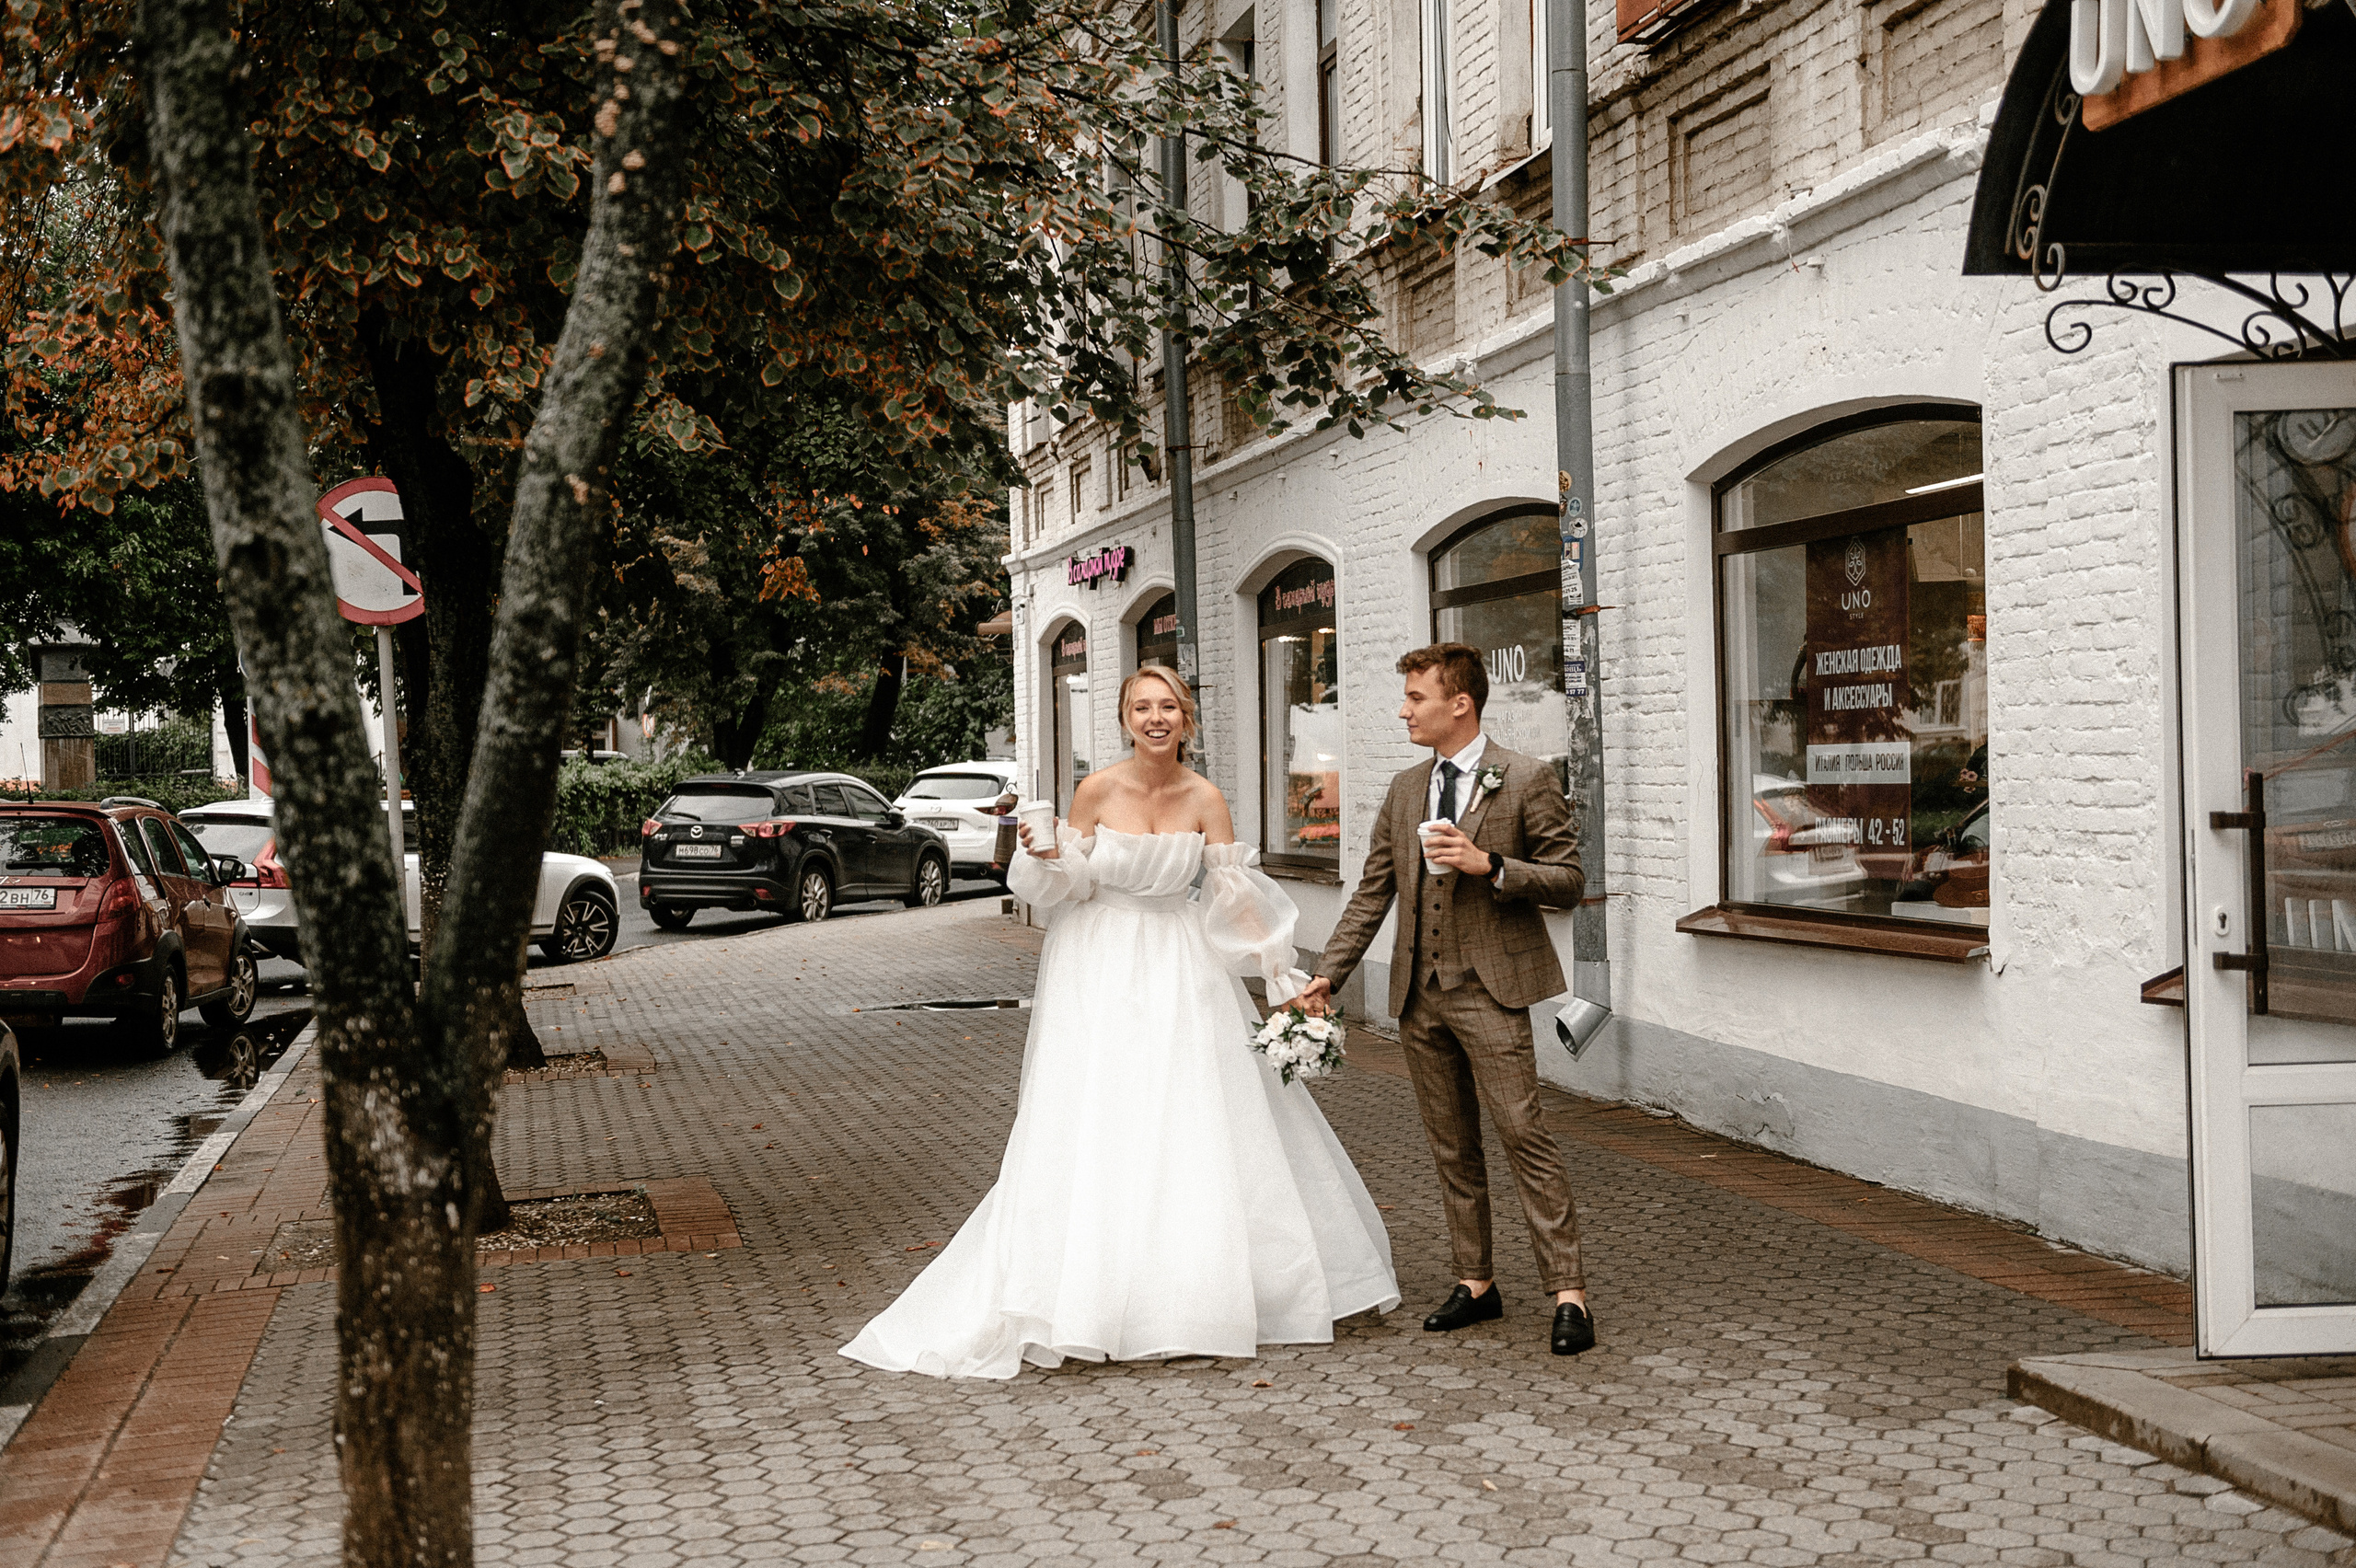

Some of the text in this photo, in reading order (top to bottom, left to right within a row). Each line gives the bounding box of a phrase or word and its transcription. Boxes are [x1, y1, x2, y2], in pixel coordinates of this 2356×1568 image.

[1842, 589, 1871, 610] UNO
[1849, 612, 1865, 620] STYLE
[1491, 644, 1526, 685] UNO
[1815, 644, 1902, 676] ЖЕНСКАЯ ОДЕЖДА
[1824, 683, 1893, 711] И АКСЕССУАРЫ
[1815, 753, 1904, 772] ИТАЛИЯ ПОЛЬША РОССИЯ
[1815, 817, 1864, 845] РАЗМЕРЫ
[1867, 818, 1884, 845] 42
[1892, 818, 1905, 846] 52
[34, 889, 49, 900] 76
